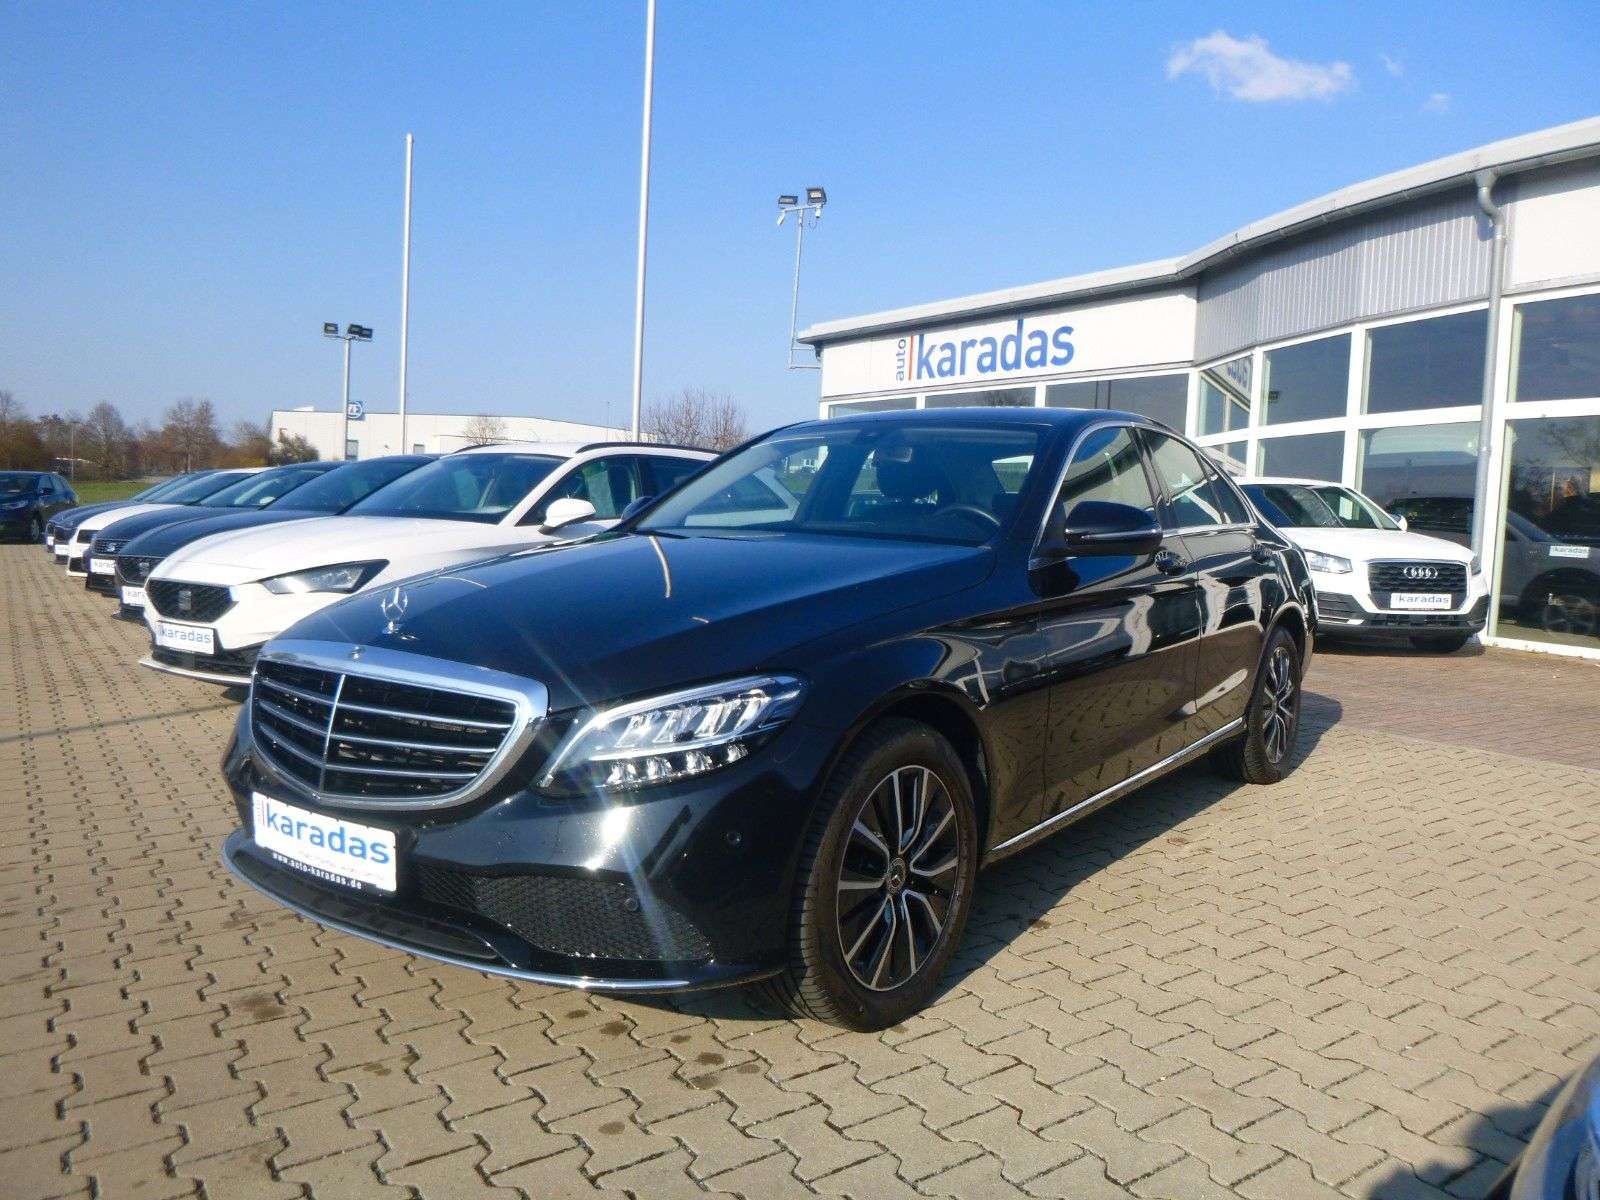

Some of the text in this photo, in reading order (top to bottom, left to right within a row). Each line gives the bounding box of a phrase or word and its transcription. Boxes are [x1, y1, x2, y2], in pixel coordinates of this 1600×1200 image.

[895, 338, 906, 381] auto
[916, 315, 1075, 380] karadas
[1399, 594, 1449, 604] karadas
[161, 624, 211, 644] karadas
[266, 802, 390, 865] karadas
[272, 852, 362, 890] www.auto-karadas.de
